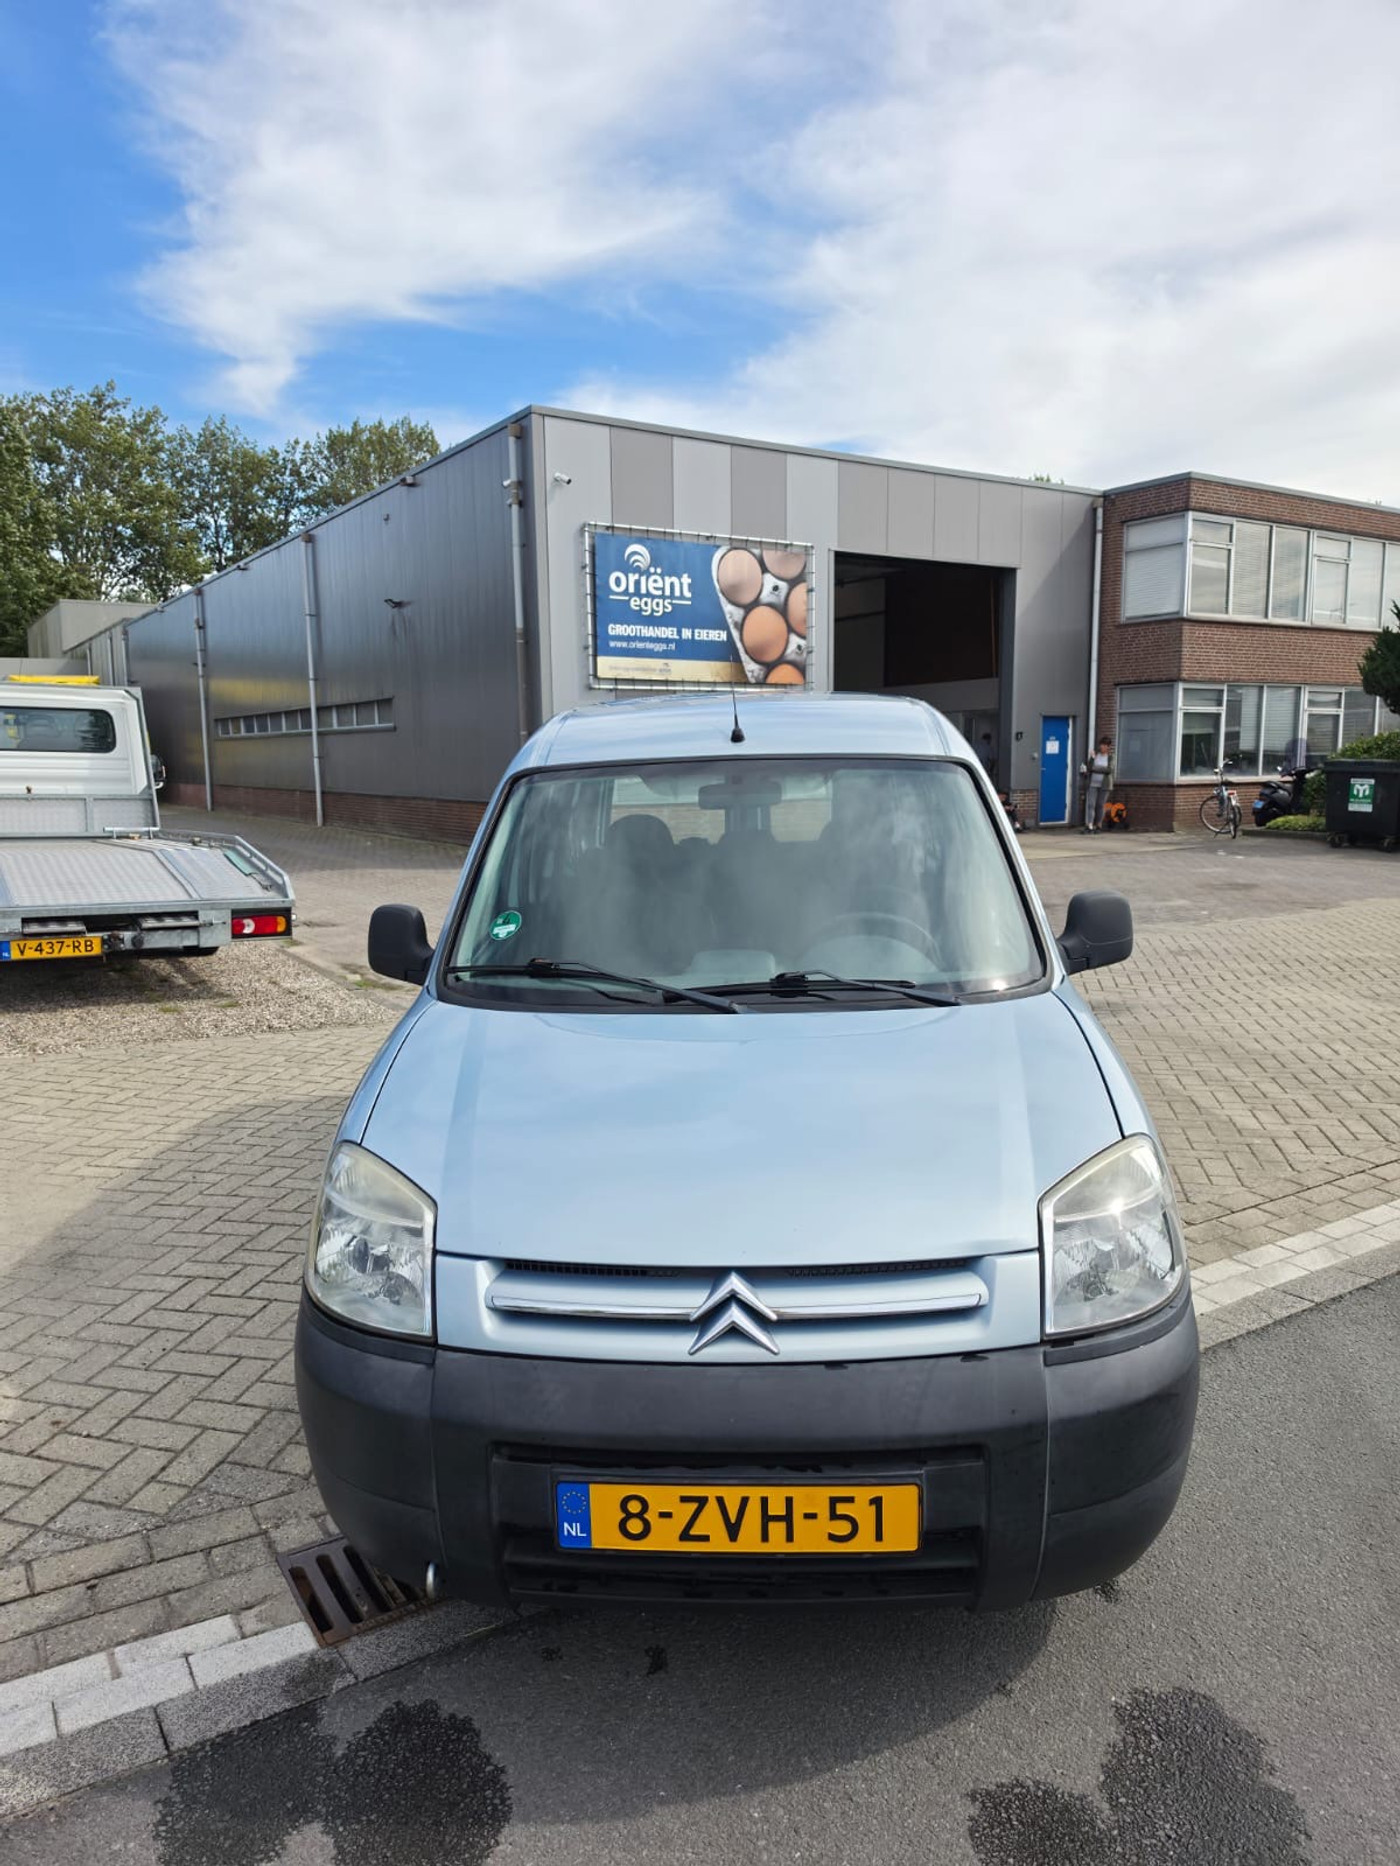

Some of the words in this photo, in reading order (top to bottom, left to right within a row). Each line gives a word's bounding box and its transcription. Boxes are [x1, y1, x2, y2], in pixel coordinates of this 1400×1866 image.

[609, 567, 692, 597] oriënt
[630, 597, 672, 616] eggs
[608, 623, 680, 639] GROOTHANDEL
[681, 628, 692, 640] IN
[694, 629, 727, 641] EIEREN
[608, 640, 676, 652] www.orienteggs.nl
[17, 940, 94, 956] V-437-RB
[618, 1494, 884, 1543] 8-ZVH-51
[563, 1521, 587, 1537] NL
